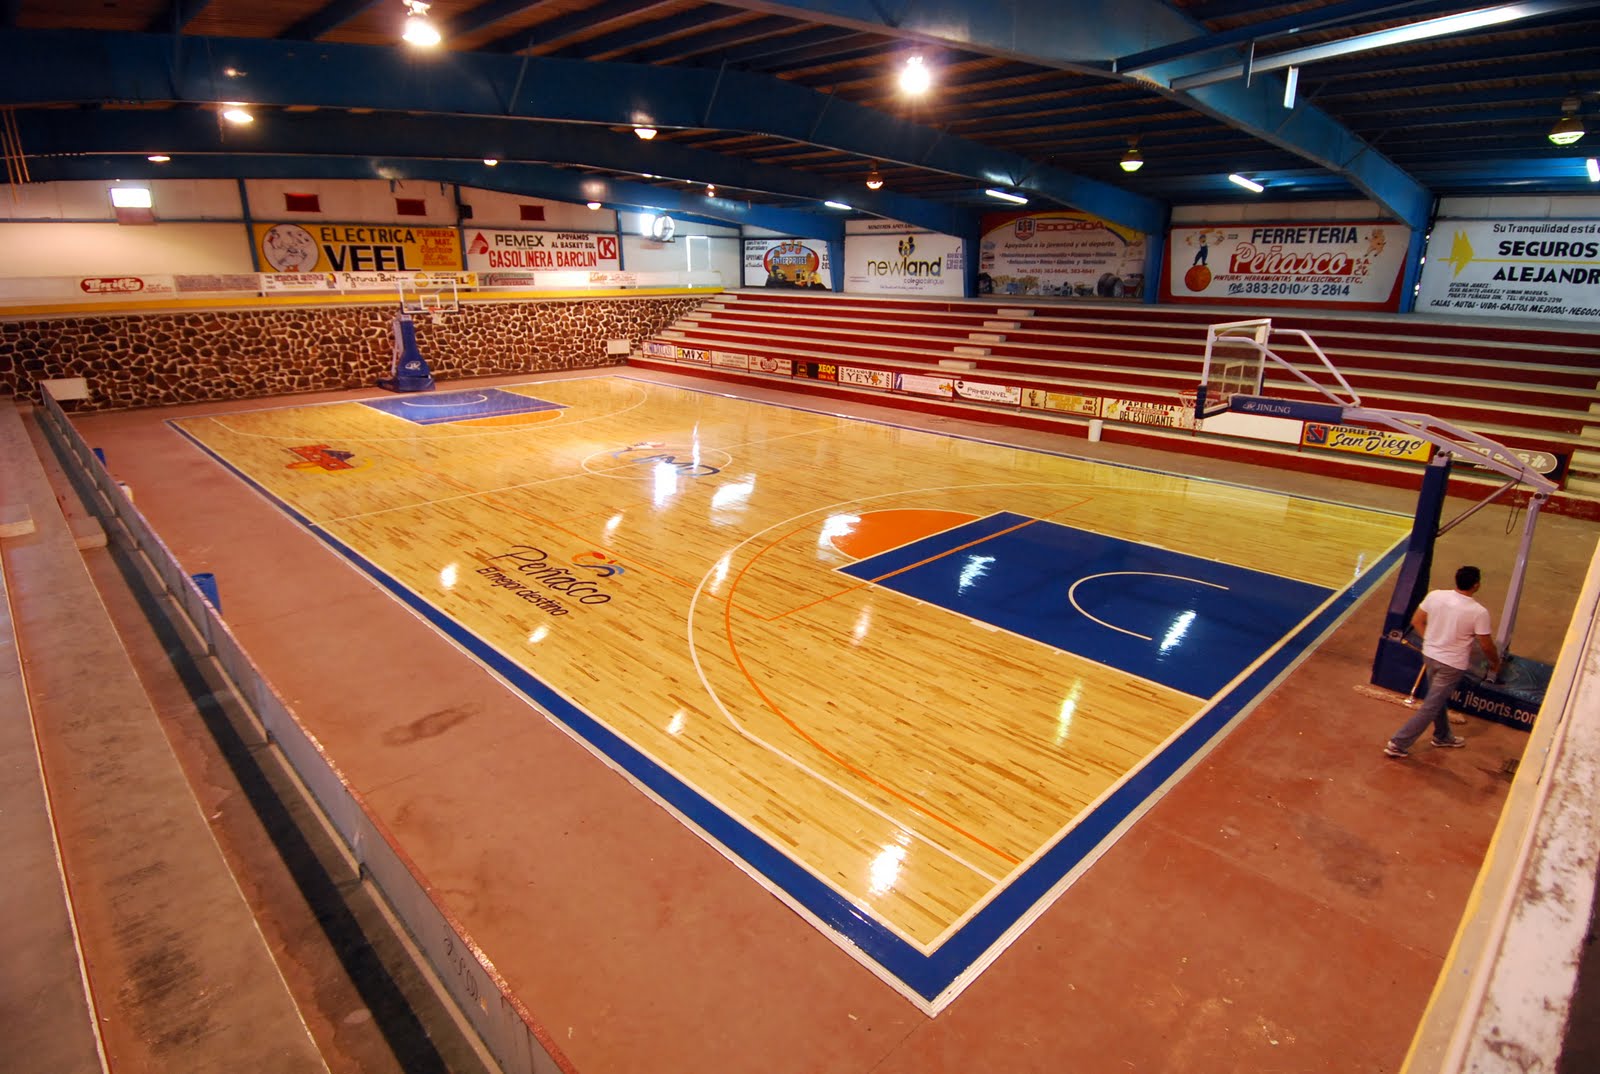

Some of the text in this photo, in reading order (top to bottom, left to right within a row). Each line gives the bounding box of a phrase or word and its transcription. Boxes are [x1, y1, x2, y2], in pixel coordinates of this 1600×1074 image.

[321, 227, 416, 243] ELECTRICA
[1251, 227, 1358, 244] FERRETERIA
[1493, 224, 1507, 233] Su
[1508, 224, 1569, 234] Tranquilidad
[1571, 224, 1596, 234] está
[495, 234, 544, 247] PEMEX
[322, 245, 421, 271] VEEL
[1234, 241, 1348, 274] Peñasco
[1498, 241, 1599, 258] SEGUROS
[488, 251, 597, 268] GASOLINERA BARCLIN
[867, 257, 941, 276] newland
[1430, 299, 1451, 307] CASAS
[1500, 303, 1528, 312] GASTOS
[818, 364, 835, 374] XEQC
[1122, 400, 1175, 412] PAPELERIA
[1256, 404, 1291, 414] JINLING
[1119, 411, 1130, 421] DEL
[1133, 413, 1174, 427] ESTUDIANTE
[1330, 433, 1425, 456] San Diego
[487, 545, 611, 604] Peñasco
[476, 566, 569, 616] El mejor destino
